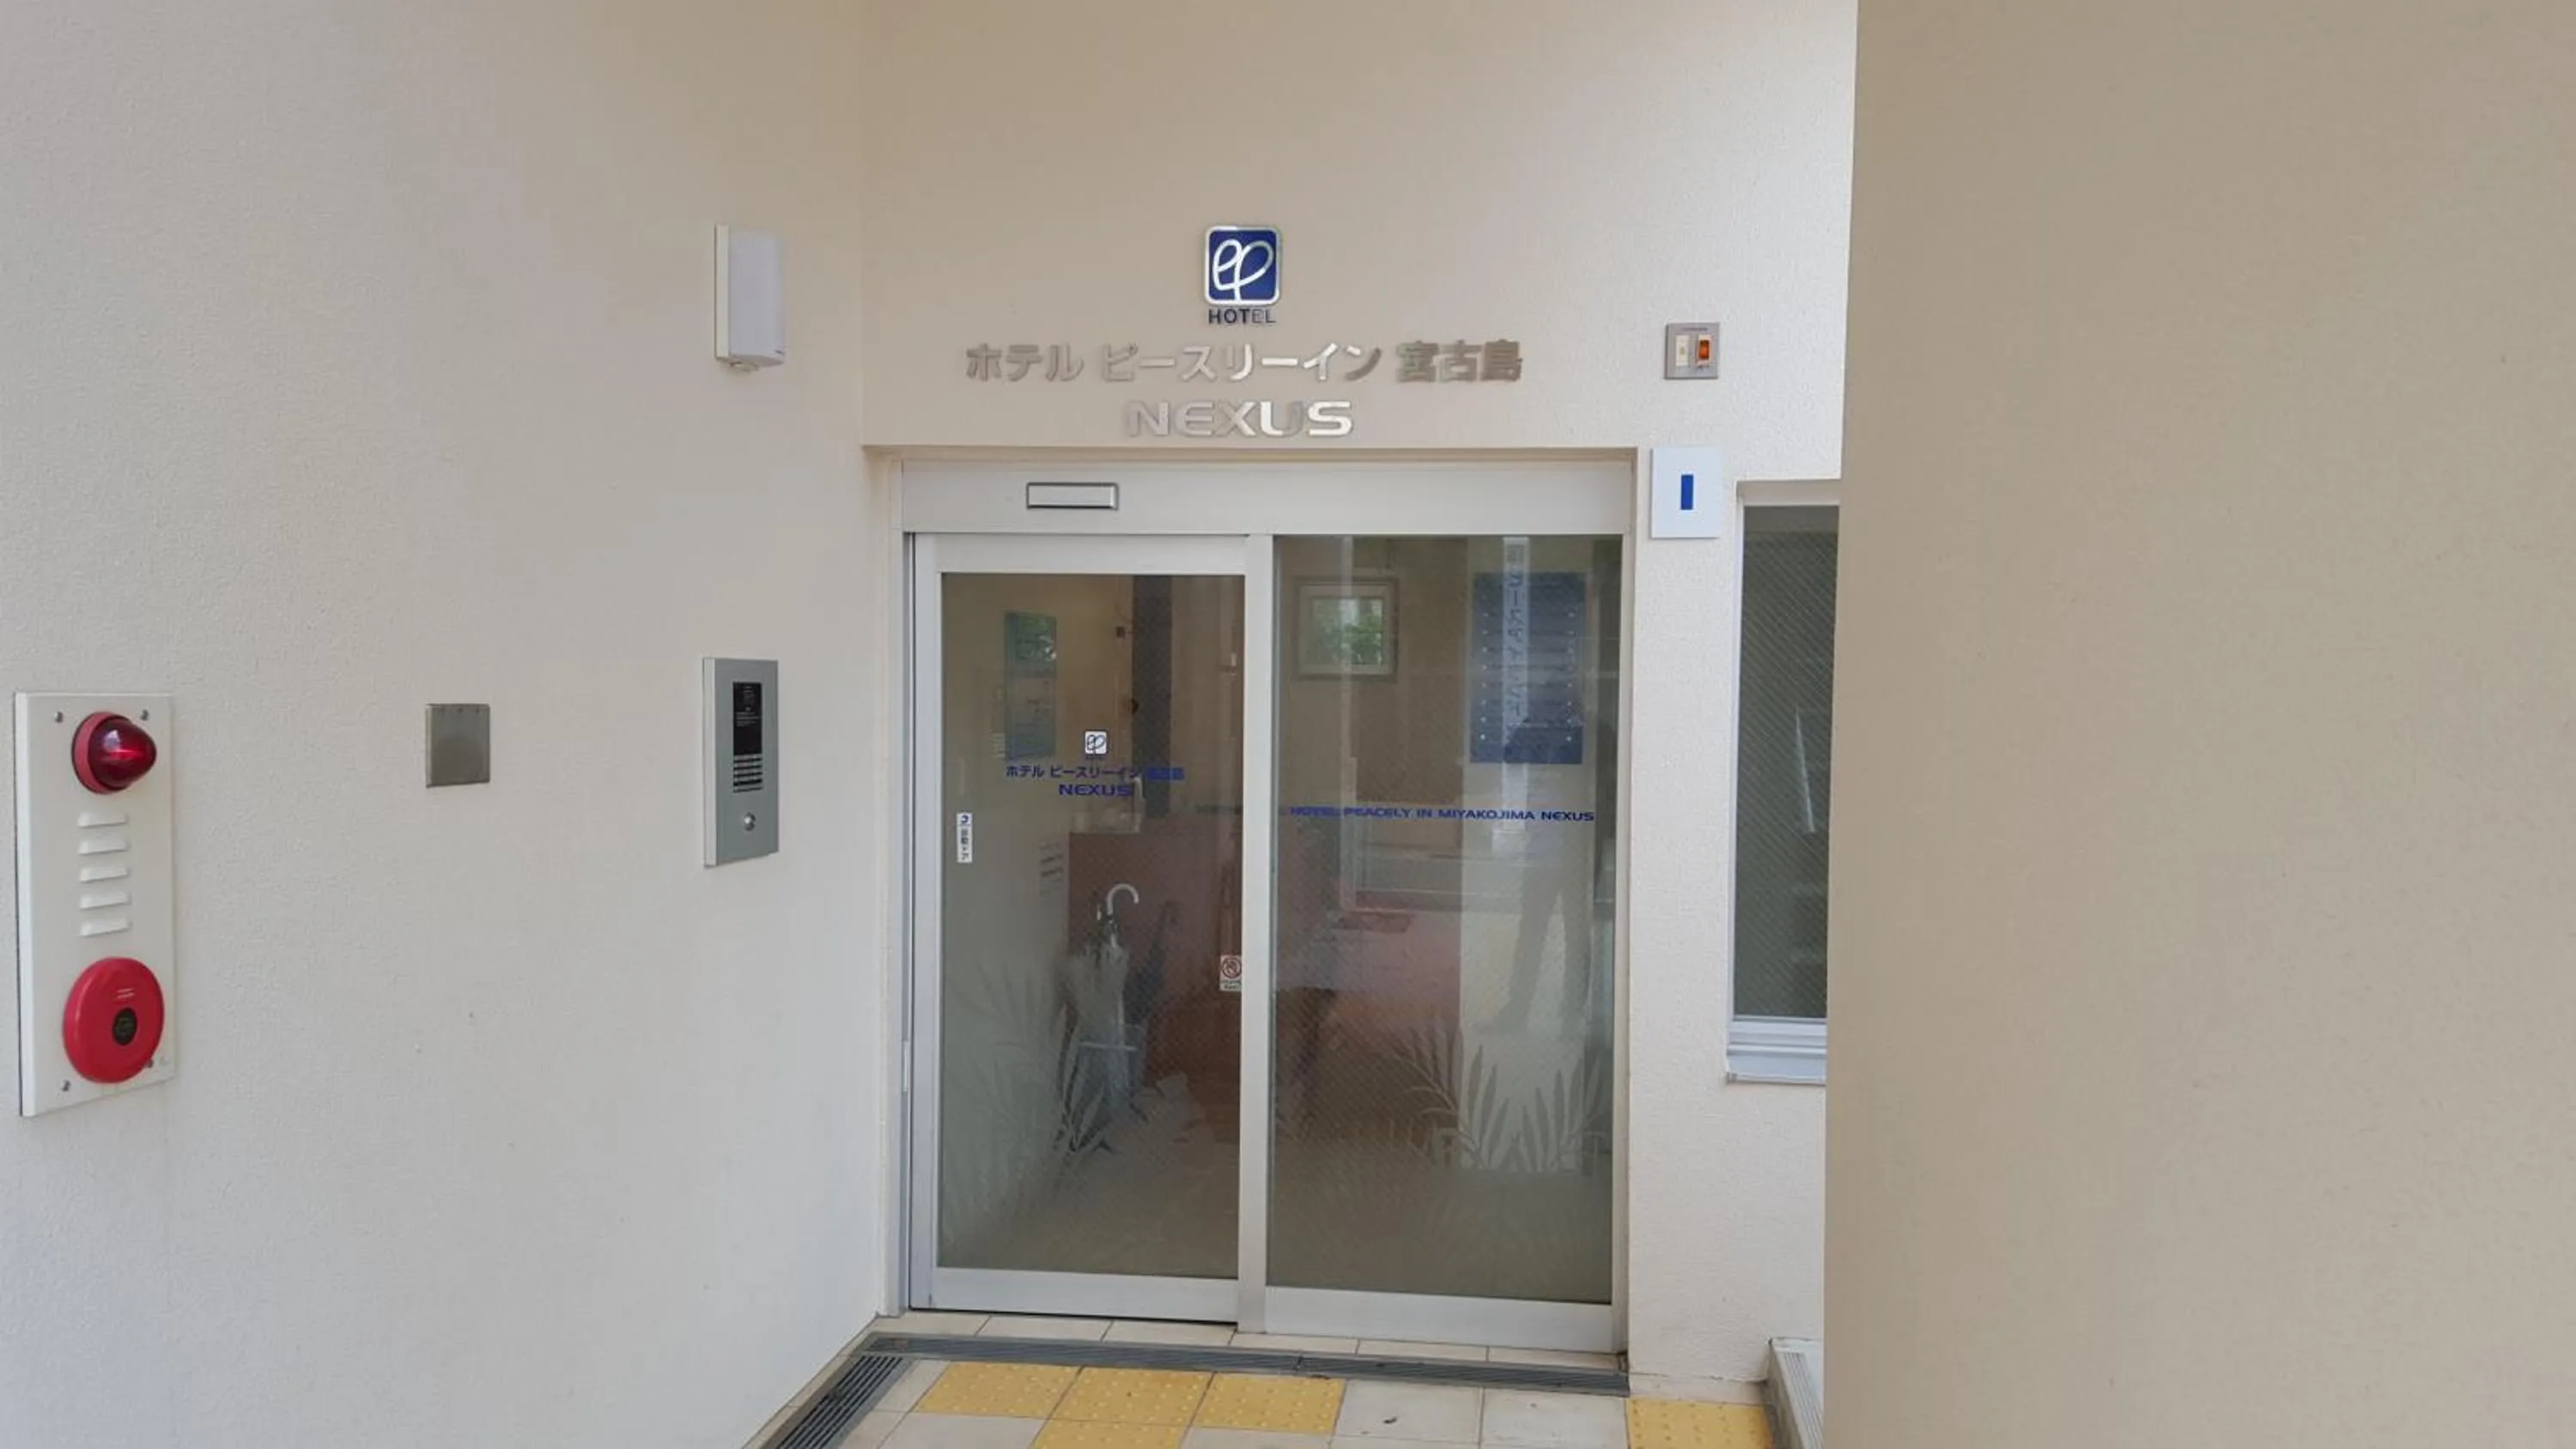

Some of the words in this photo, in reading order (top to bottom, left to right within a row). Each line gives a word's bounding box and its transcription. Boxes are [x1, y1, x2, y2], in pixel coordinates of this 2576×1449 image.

[1207, 308, 1276, 325] HOTEL
[964, 343, 1084, 383] ホテル
[1100, 342, 1384, 383] ピースリーイン
[1395, 340, 1523, 384] 宮古島
[1127, 400, 1354, 439] NEXUS
[1005, 765, 1045, 779] ホテル
[1058, 784, 1133, 797] NEXUS
[1343, 807, 1412, 820] PEACELY
[1416, 809, 1433, 820] IN
[1438, 809, 1536, 822] MIYAKOJIMA
[1540, 811, 1595, 822] NEXUS
